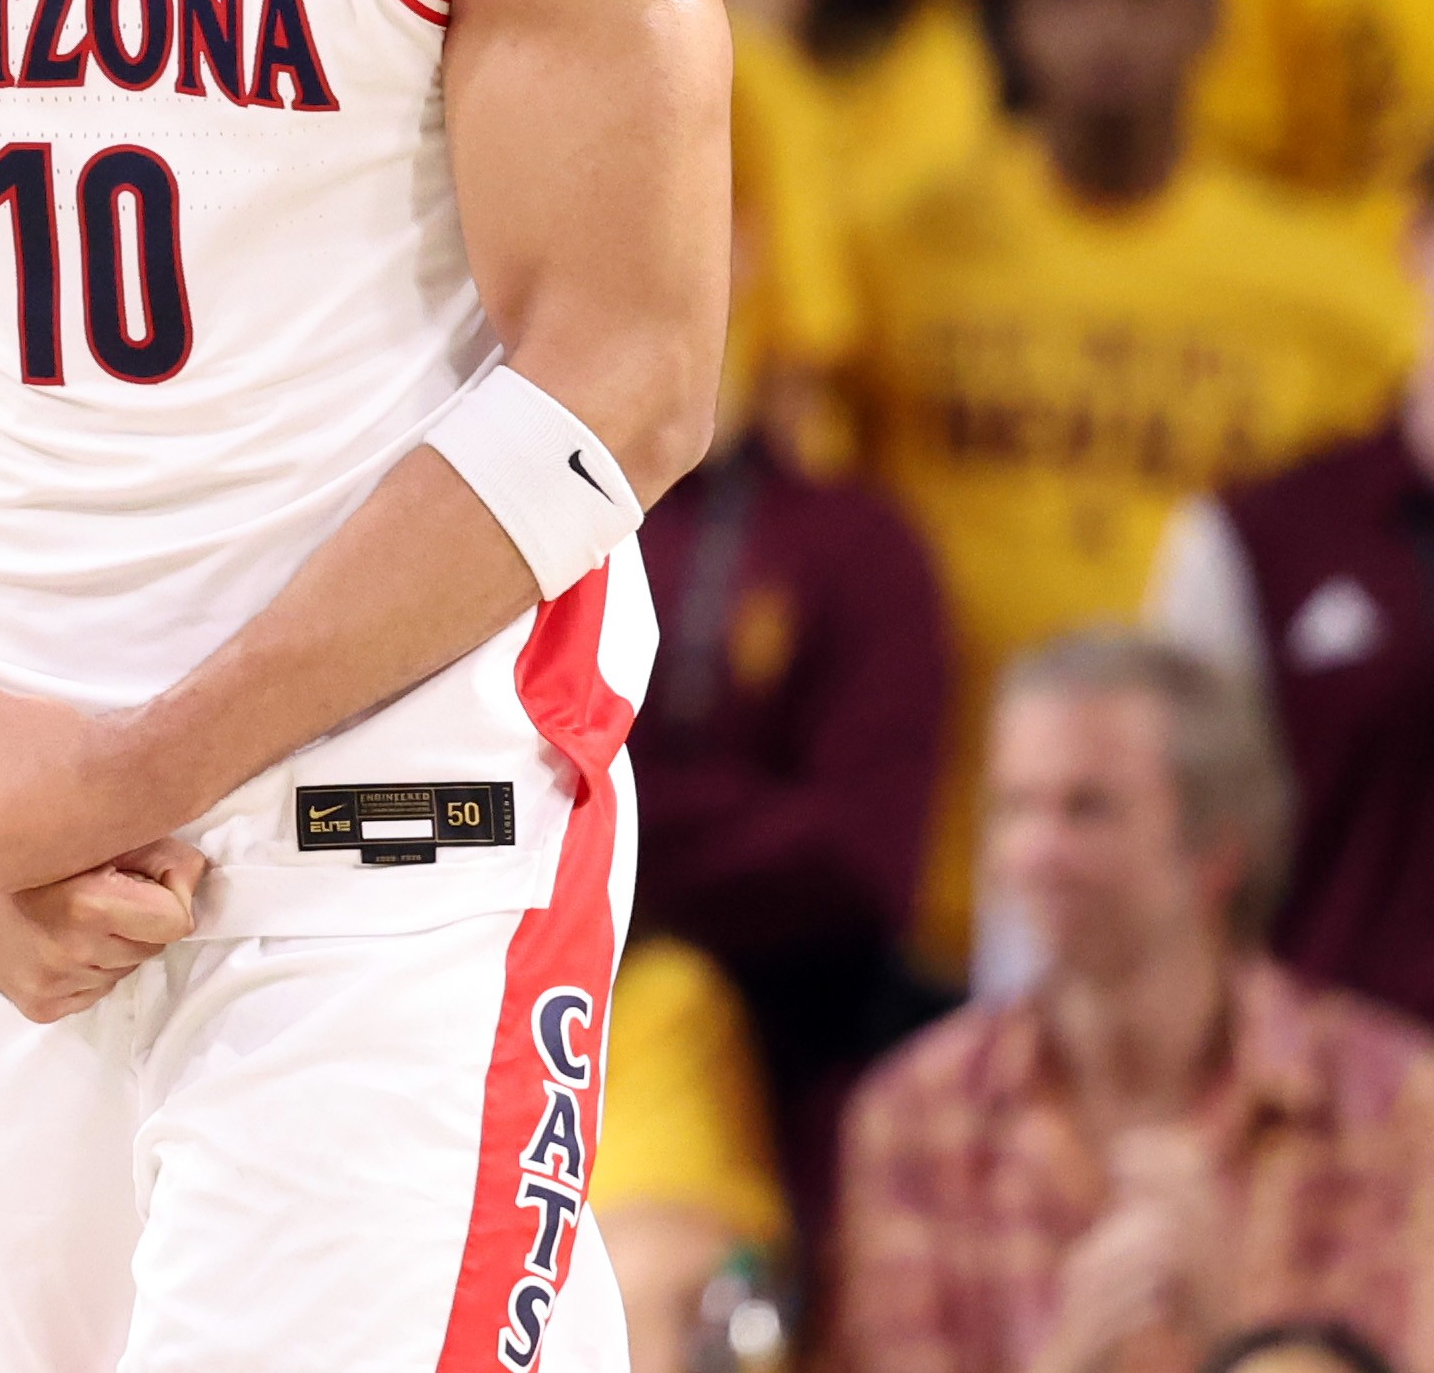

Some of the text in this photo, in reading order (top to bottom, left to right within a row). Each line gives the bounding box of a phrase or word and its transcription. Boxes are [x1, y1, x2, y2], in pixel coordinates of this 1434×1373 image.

[309, 819, 351, 833] ELITE
[446, 801, 481, 827] 50
[496, 985, 593, 1373] CATS
